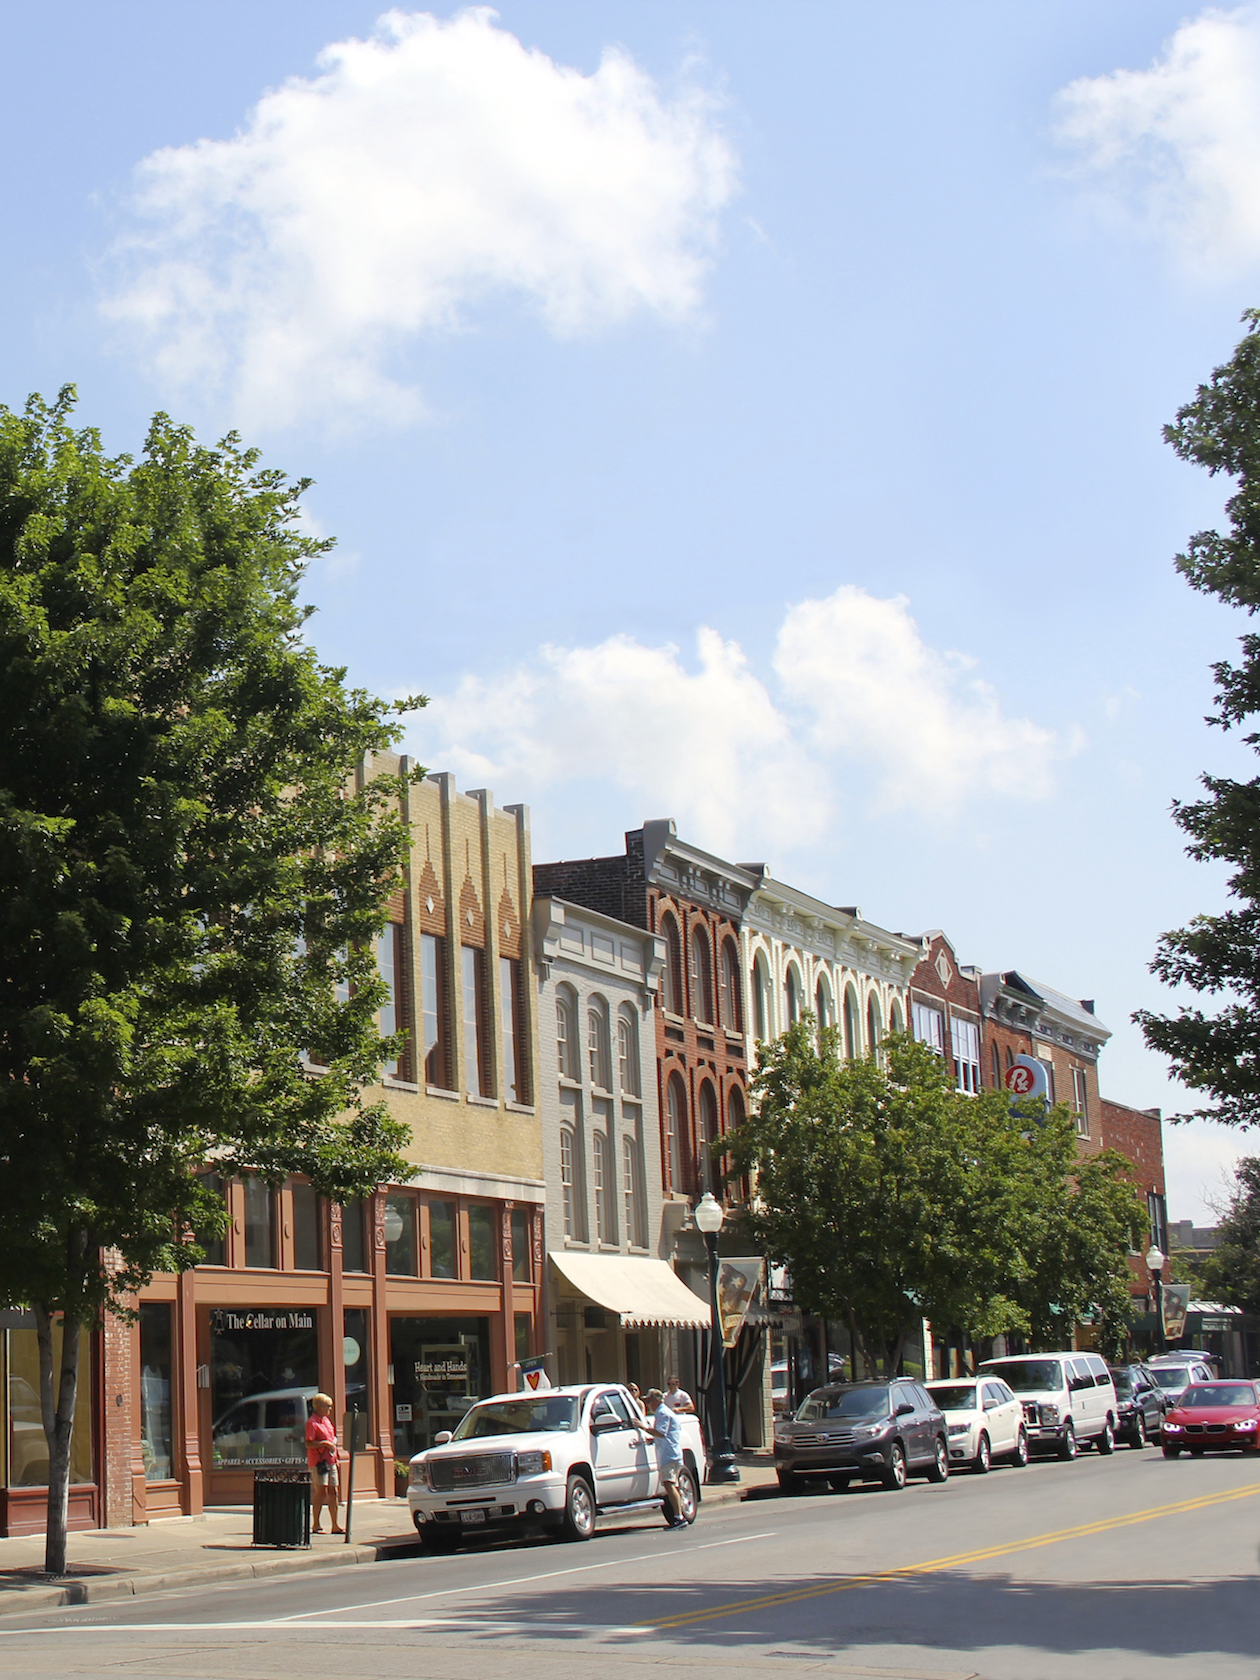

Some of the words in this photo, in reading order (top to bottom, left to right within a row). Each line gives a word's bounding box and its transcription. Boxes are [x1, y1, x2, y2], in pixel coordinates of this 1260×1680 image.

[226, 1313, 244, 1330] The
[246, 1313, 274, 1330] Cellar
[275, 1318, 287, 1329] on
[288, 1312, 312, 1329] Main
[414, 1361, 433, 1373] Heart
[434, 1361, 446, 1372] and
[447, 1360, 468, 1372] Hands
[217, 1458, 241, 1466] APPAREL
[245, 1457, 282, 1465] ACCESSORIES
[284, 1456, 302, 1465] GIFTS
[451, 1465, 489, 1479] GMC
